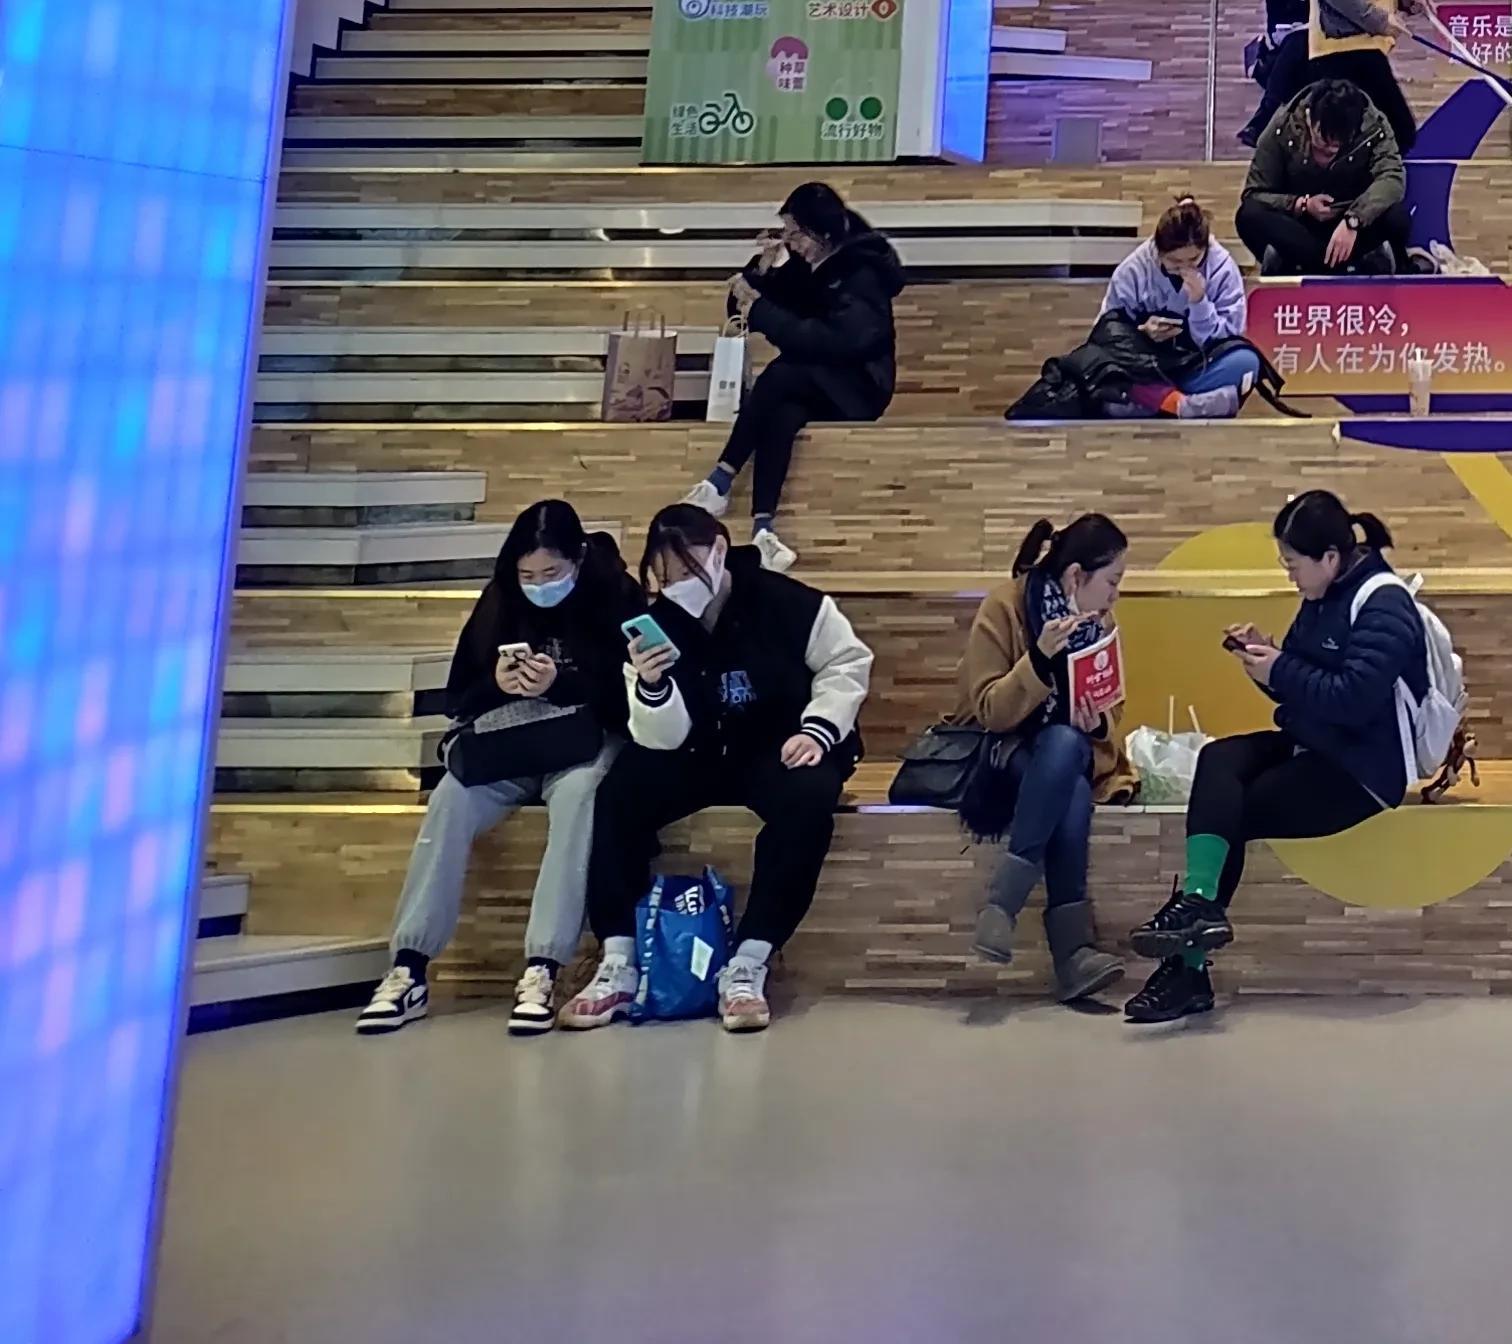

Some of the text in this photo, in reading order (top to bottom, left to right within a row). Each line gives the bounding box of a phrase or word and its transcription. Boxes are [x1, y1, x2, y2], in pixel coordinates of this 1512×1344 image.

[808, 2, 870, 17] 艺术设计
[780, 62, 805, 75] 种草
[822, 122, 883, 138] 流行好物
[1273, 304, 1410, 337] 世界很冷，
